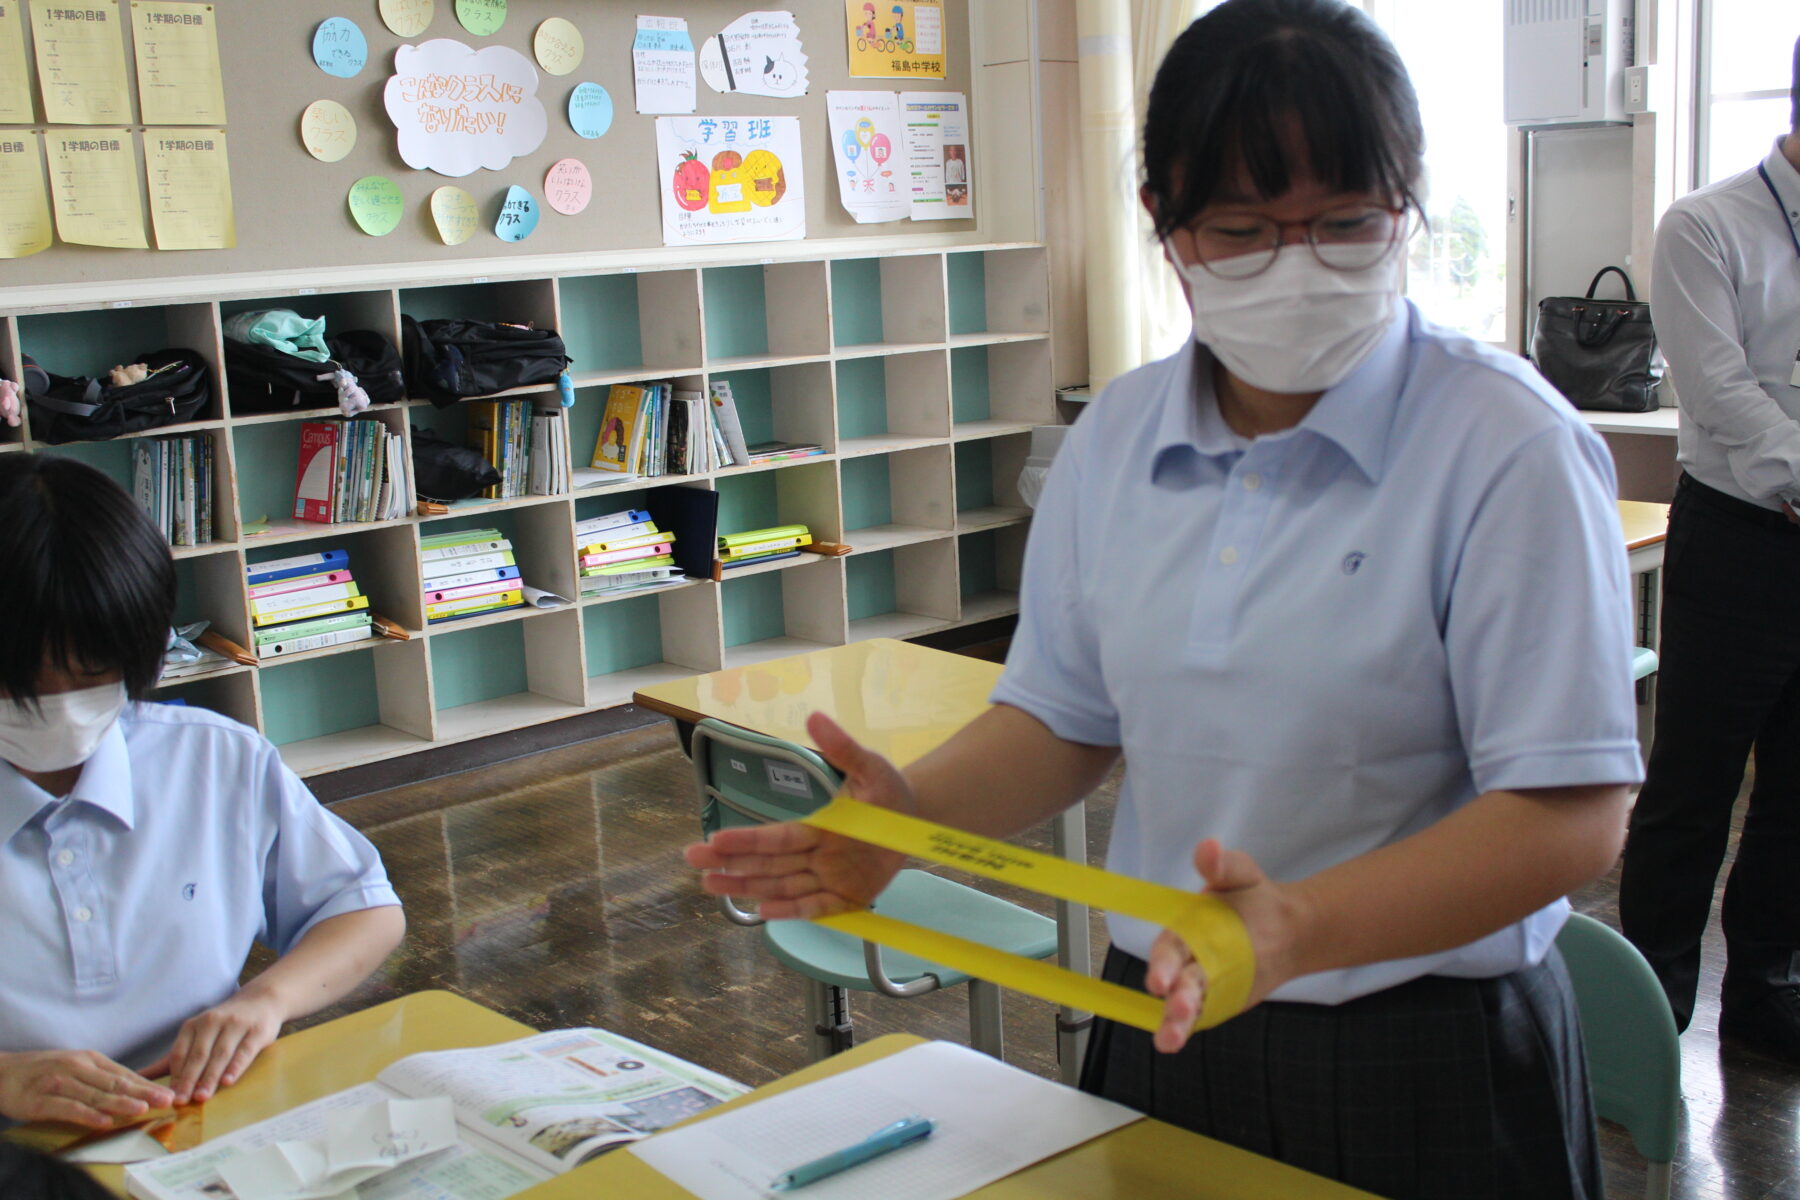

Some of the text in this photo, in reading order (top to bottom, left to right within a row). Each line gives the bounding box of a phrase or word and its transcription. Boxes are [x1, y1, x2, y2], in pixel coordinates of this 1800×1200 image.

[46, 9, 107, 22] 1学期の目標
[146, 13, 203, 26] 1学期の目標
[463, 7, 493, 22] クラス
[320, 22, 351, 45] 協力
[891, 59, 942, 73] 福島中学校
[399, 72, 524, 105] こんなクラスに
[417, 102, 507, 136] なりたい!
[697, 118, 773, 143] 学習班
[61, 140, 121, 153] 1学期の目標
[159, 140, 215, 152] 1学期の目標
[555, 189, 581, 205] クラス
[499, 213, 521, 226] クラス
[303, 429, 331, 447] Campus
